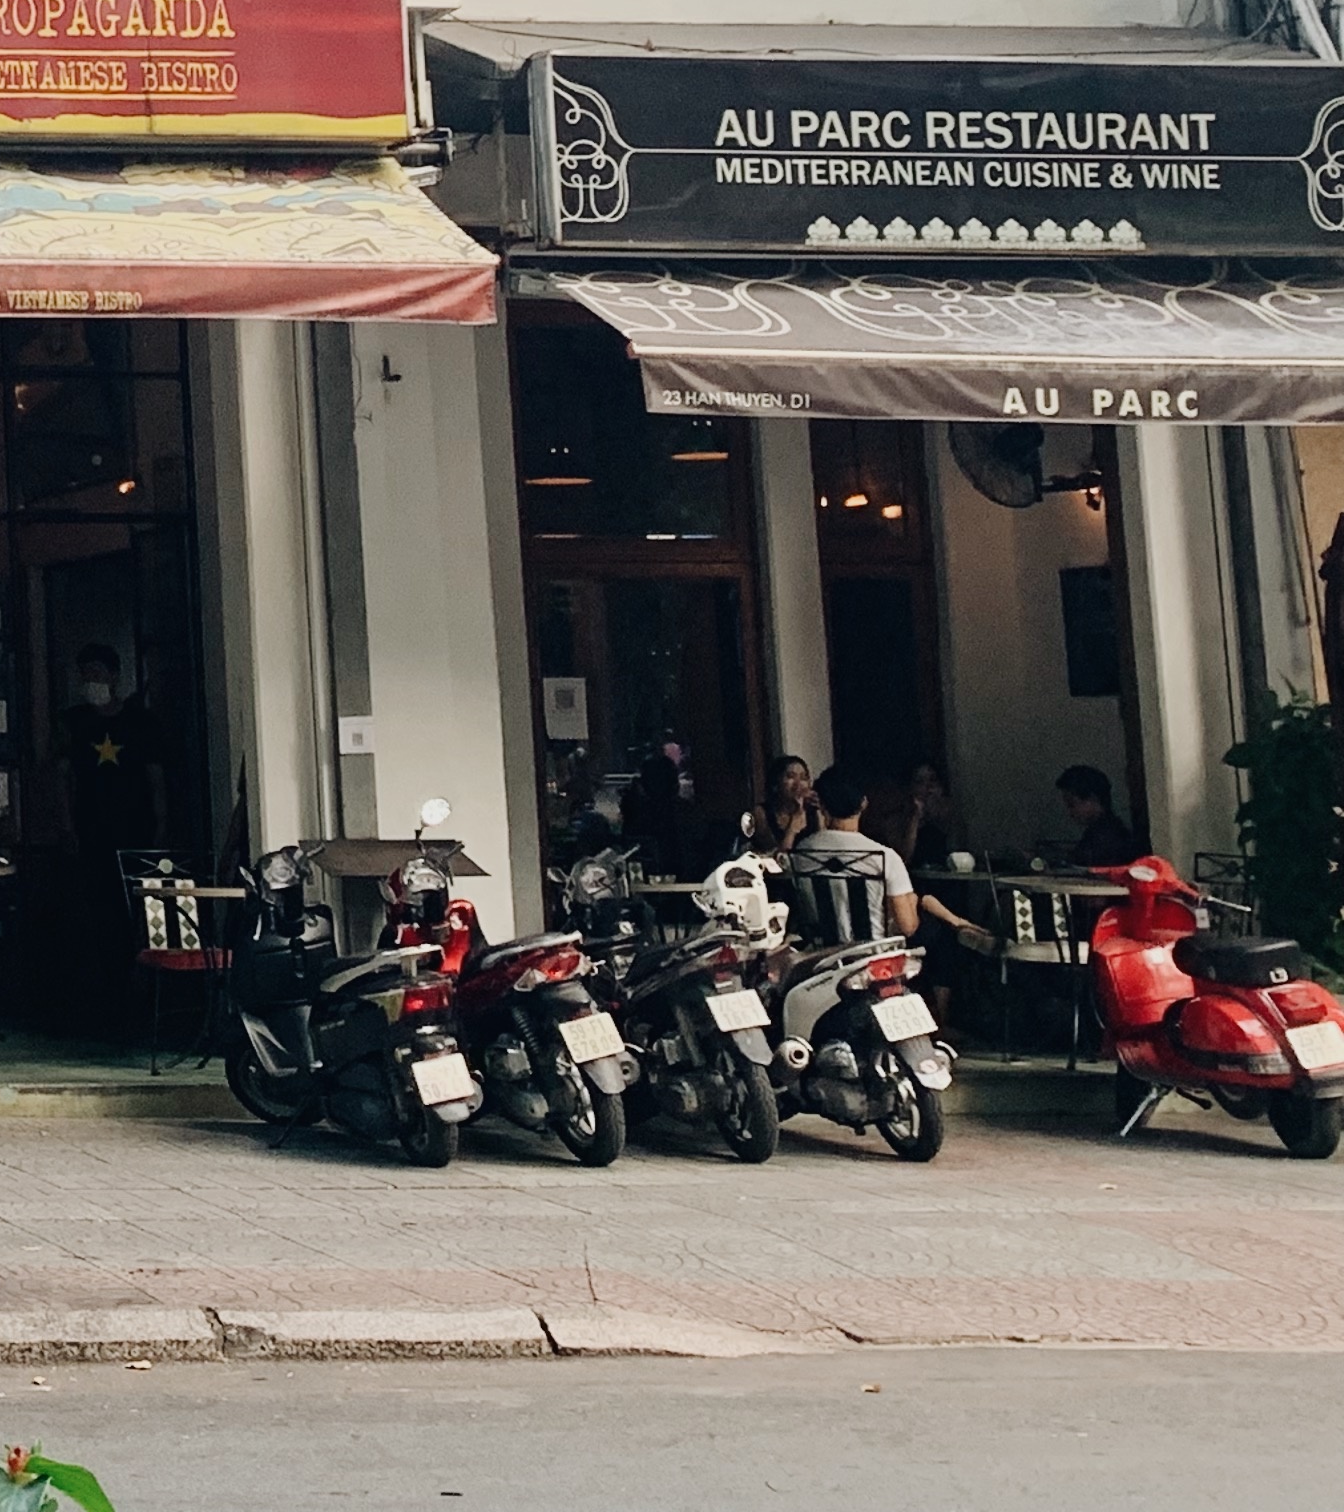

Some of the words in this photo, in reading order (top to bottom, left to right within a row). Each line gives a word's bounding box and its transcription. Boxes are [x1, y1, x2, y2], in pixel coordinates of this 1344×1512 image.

[140, 62, 239, 93] BISTRO
[714, 109, 775, 148] AU
[790, 110, 911, 149] PARC
[925, 111, 1216, 152] RESTAURANT
[715, 157, 975, 187] MEDITERRANEAN
[983, 160, 1101, 188] CUISINE
[1109, 163, 1134, 188] &
[1139, 163, 1221, 189] WINE
[6, 289, 90, 310] VIETNAMESE
[94, 291, 143, 311] BISTRO
[662, 390, 682, 406] 23
[684, 391, 721, 407] HAN
[1002, 387, 1061, 416] AU
[1092, 388, 1200, 418] PARC
